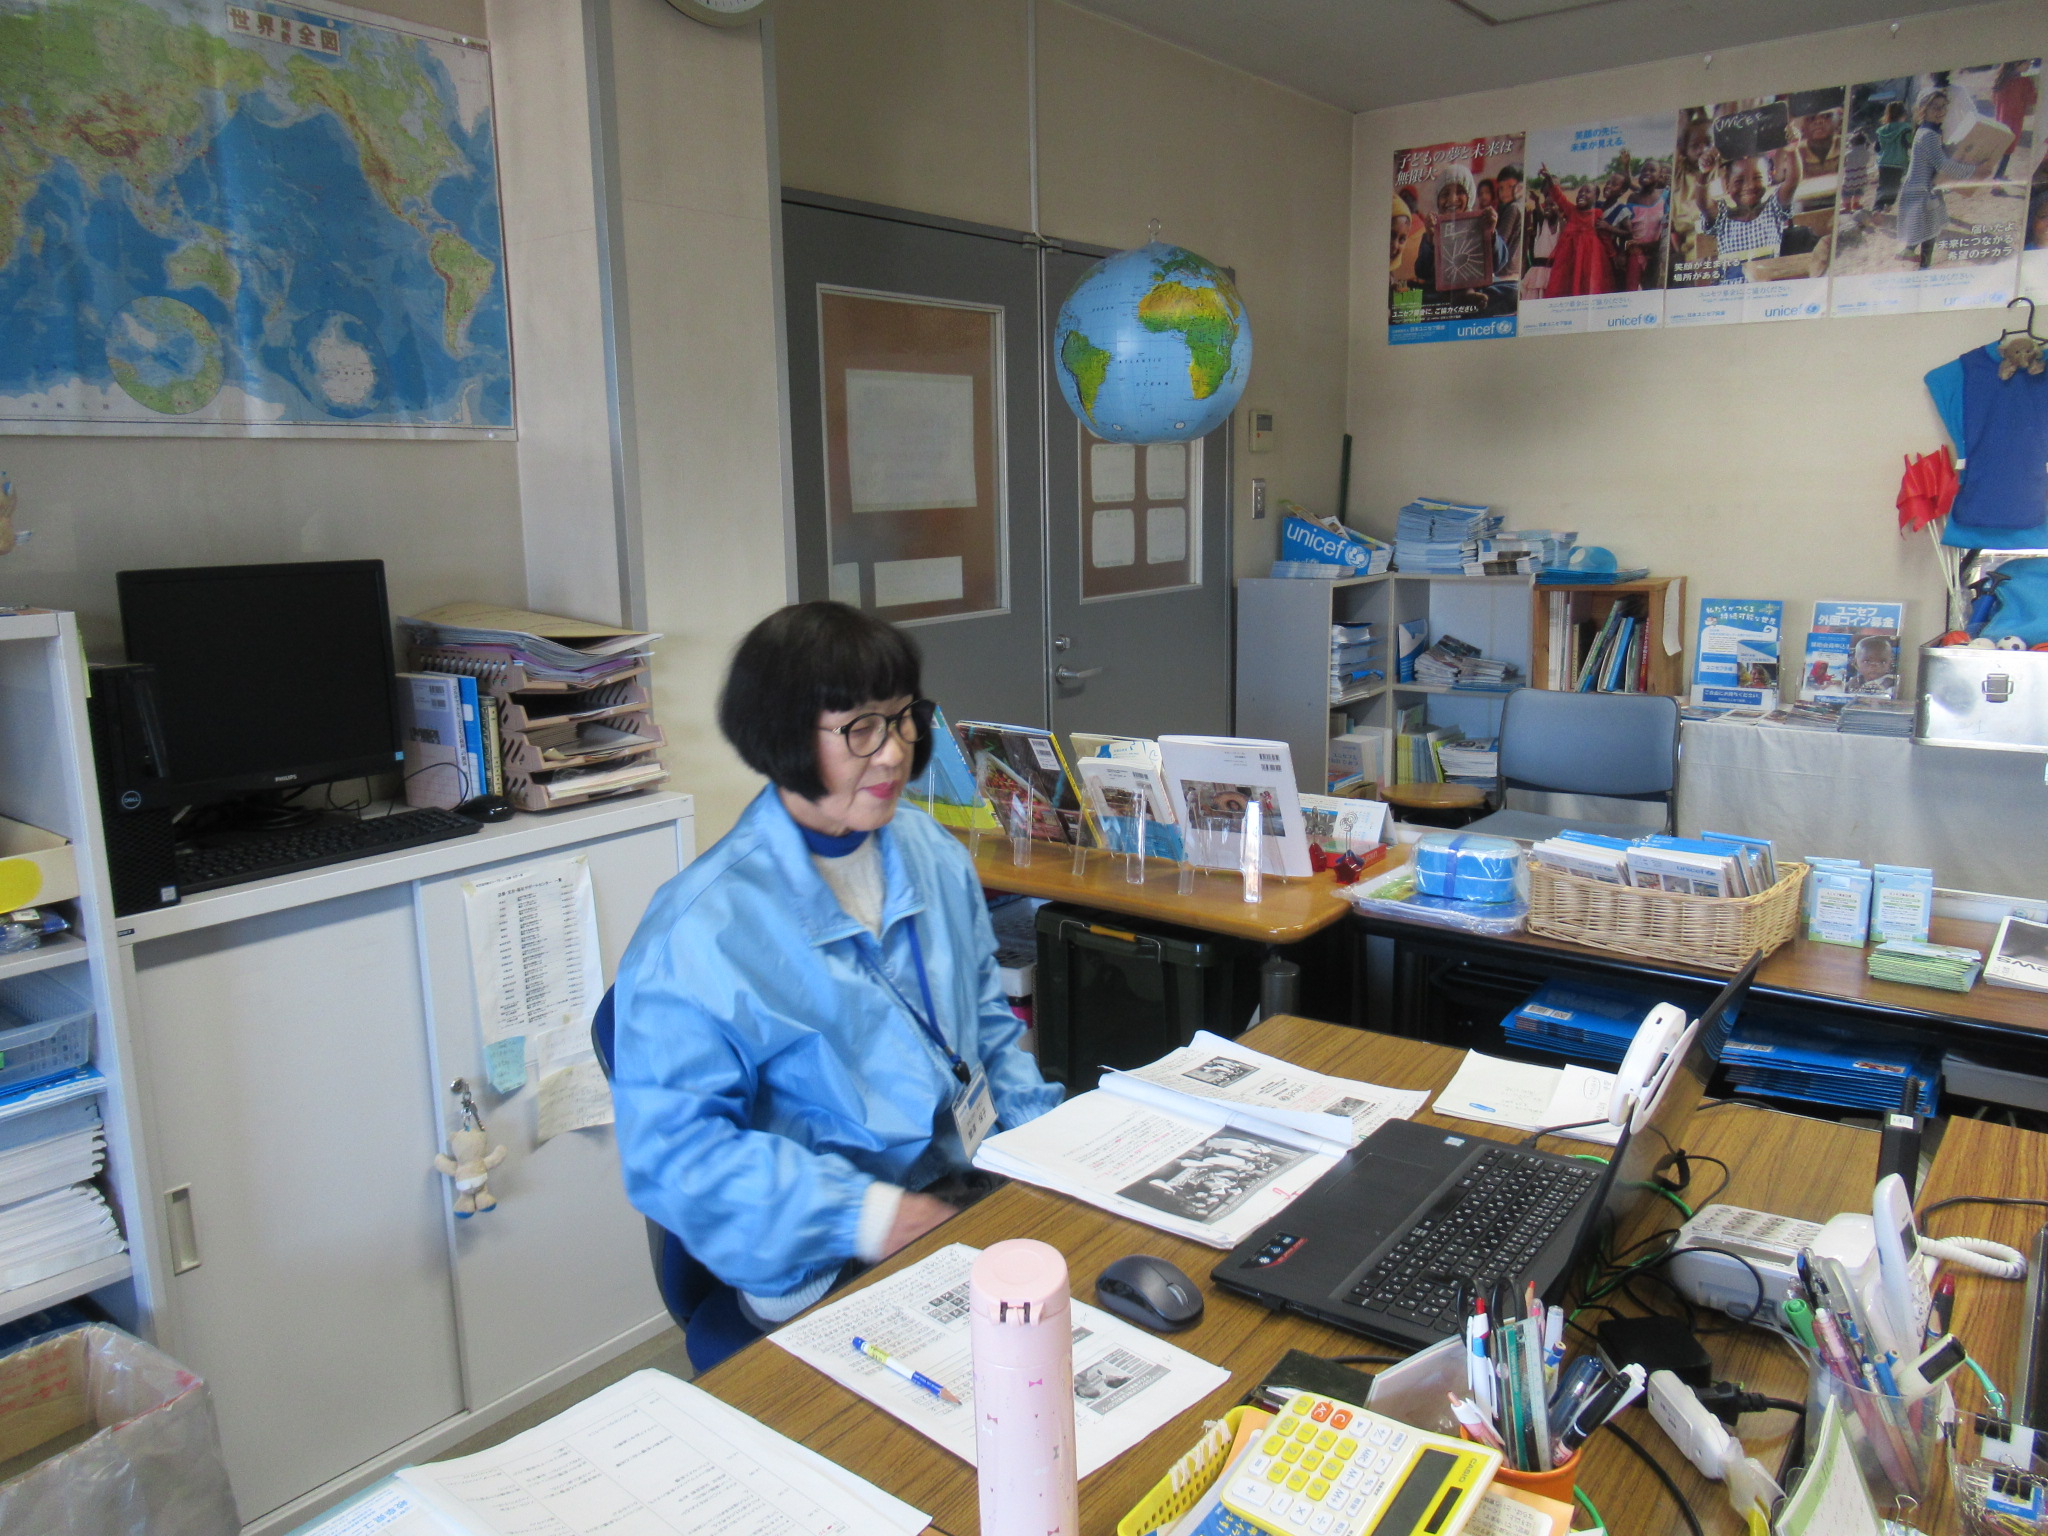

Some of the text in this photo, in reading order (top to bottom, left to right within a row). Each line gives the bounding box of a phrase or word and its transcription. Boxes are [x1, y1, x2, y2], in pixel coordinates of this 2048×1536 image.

[1400, 140, 1514, 169] 子どもの夢と未来は
[1395, 167, 1437, 186] 無限大
[1971, 222, 2016, 235] 届いたよ
[1938, 236, 2014, 249] 未来につながる
[1947, 247, 2014, 260] 希望のチカラ
[1673, 258, 1742, 272] 笑顔が生まれる
[1607, 313, 1643, 328] unicef
[1457, 321, 1496, 337] unicef
[1286, 523, 1347, 560] unicef
[1835, 606, 1878, 617] ユニセフ
[1817, 614, 1895, 628] 外国コイン募金
[274, 774, 298, 782] PHILIPS
[1676, 864, 1704, 875] unicef
[1313, 1403, 1328, 1419] AC
[1334, 1413, 1347, 1423] C
[1319, 1435, 1330, 1444] 4
[1286, 1447, 1297, 1456] 2
[1340, 1442, 1353, 1452] 7
[1305, 1454, 1317, 1463] 5
[1272, 1467, 1283, 1476] 3
[1458, 1458, 1478, 1483] CASIO
[1312, 1483, 1323, 1492] 9
